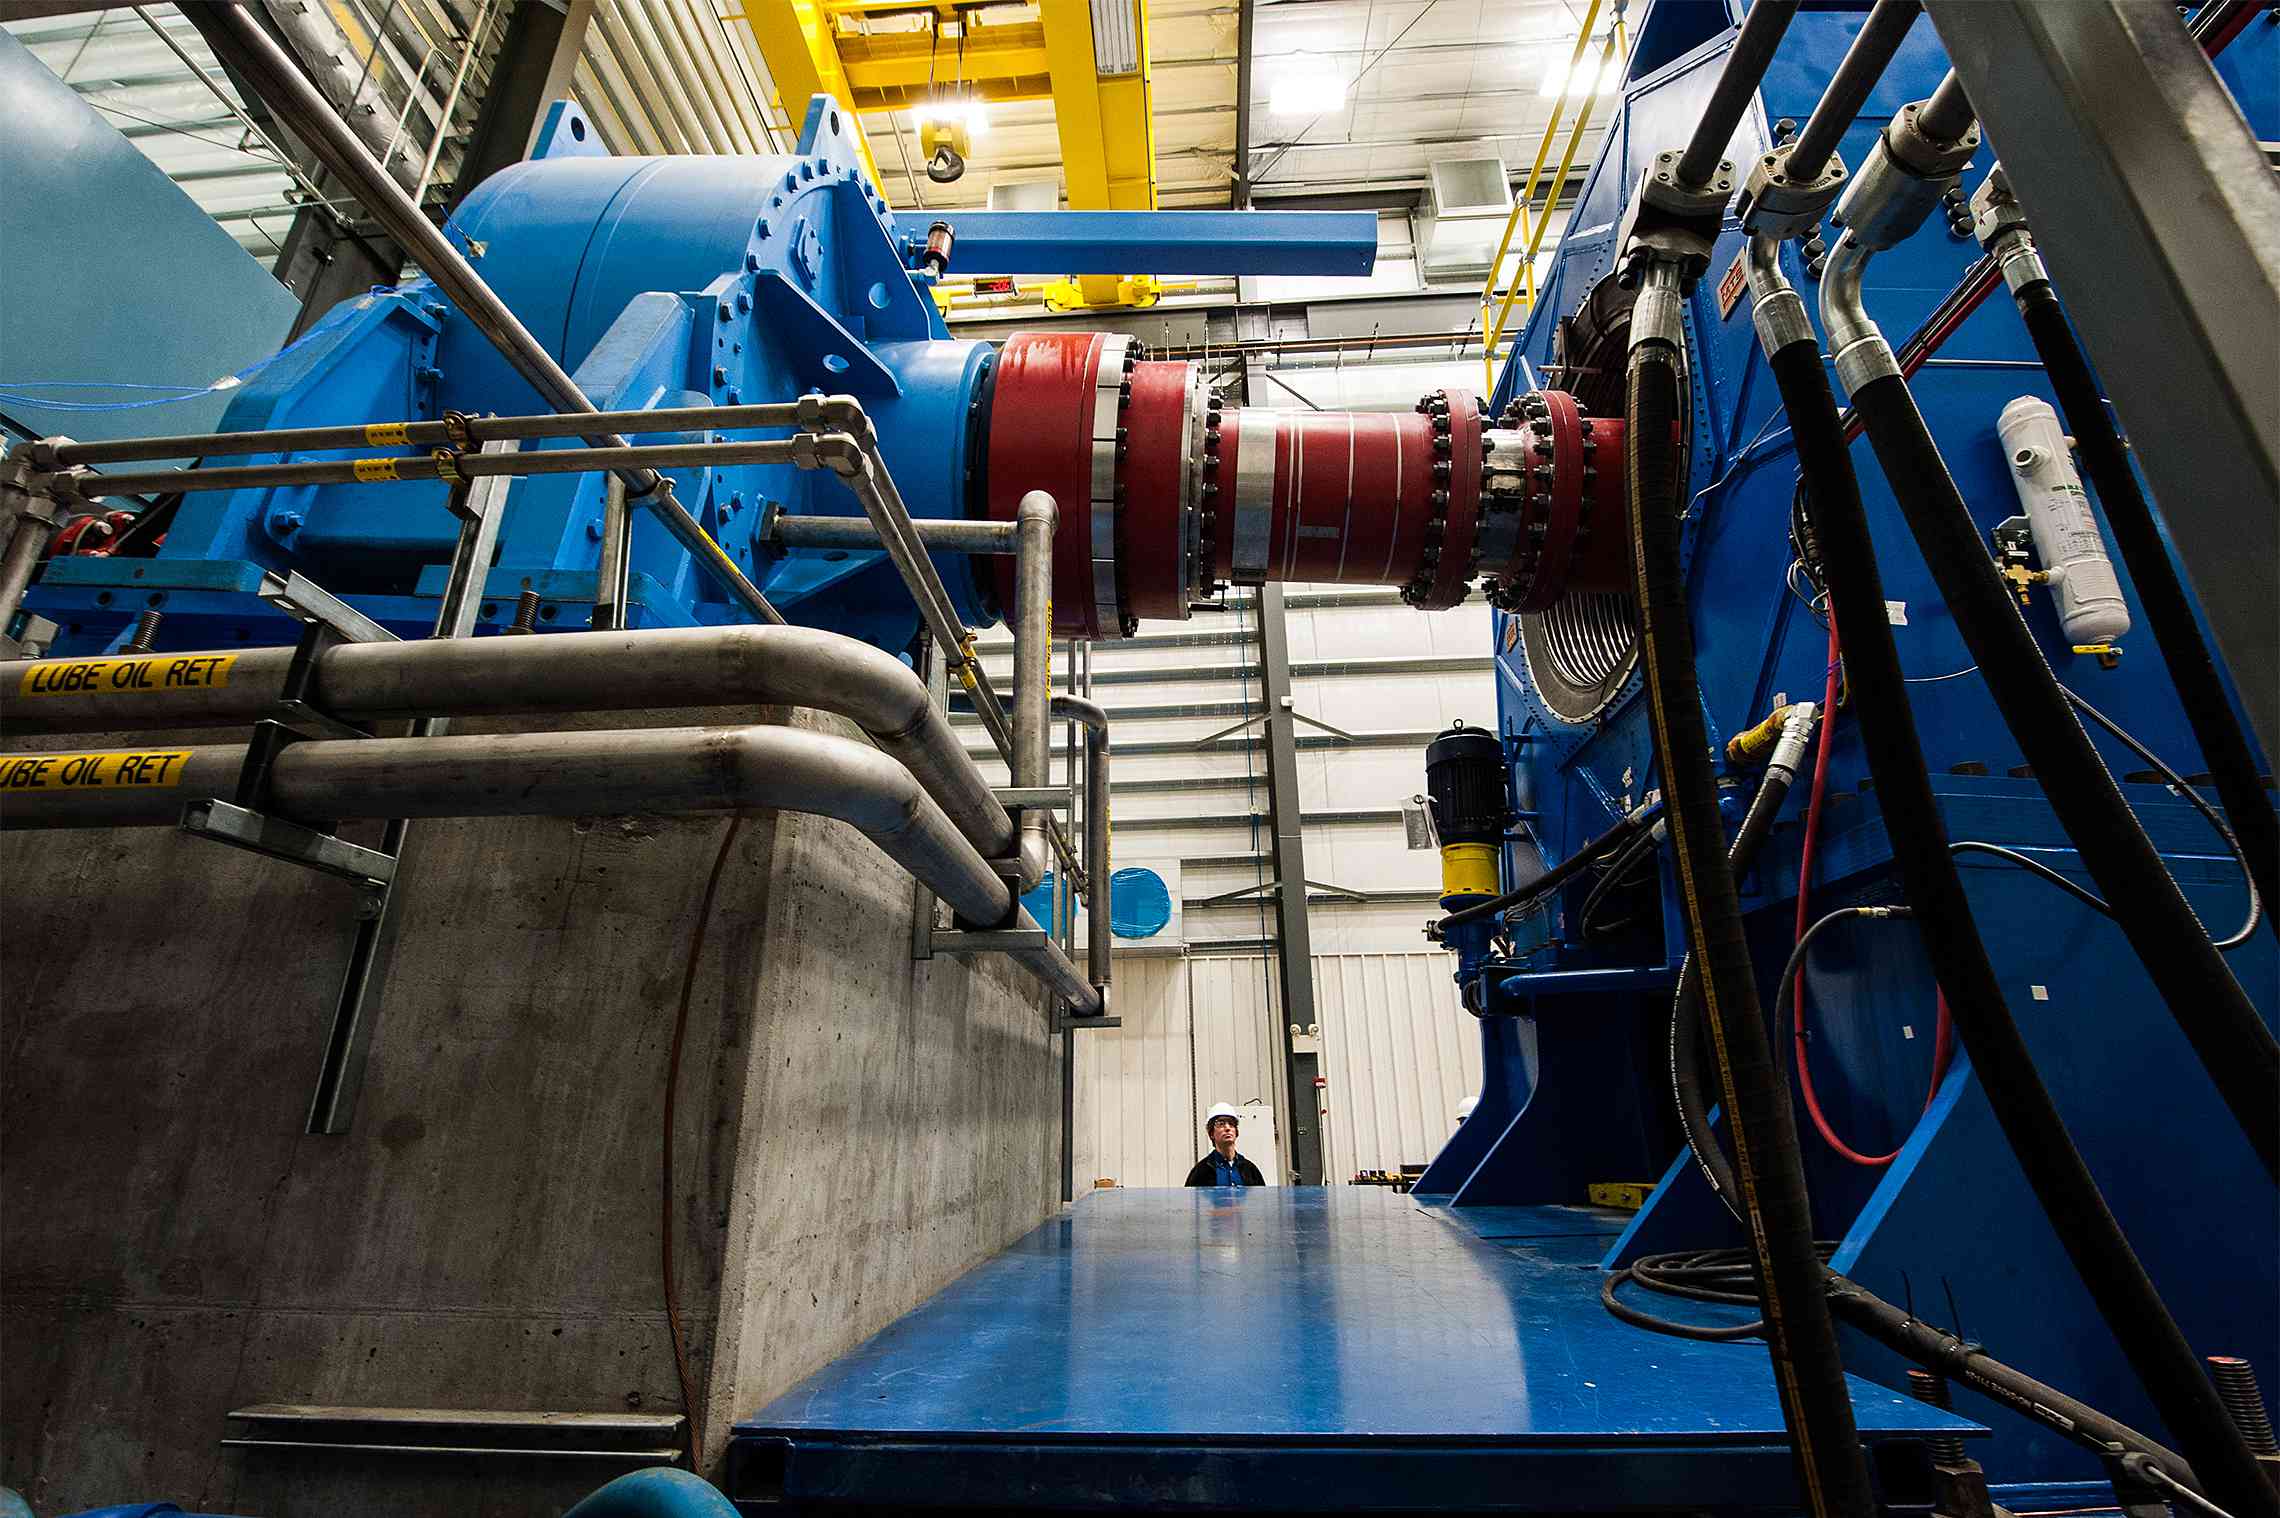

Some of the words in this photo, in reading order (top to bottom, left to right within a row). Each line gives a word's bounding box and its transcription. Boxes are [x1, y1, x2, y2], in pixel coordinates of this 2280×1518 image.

[31, 664, 107, 692] LUBE
[111, 661, 153, 689] OIL
[165, 658, 225, 686] RET
[0, 759, 58, 788] UBE
[61, 757, 105, 785] OIL
[115, 755, 180, 784] RET
